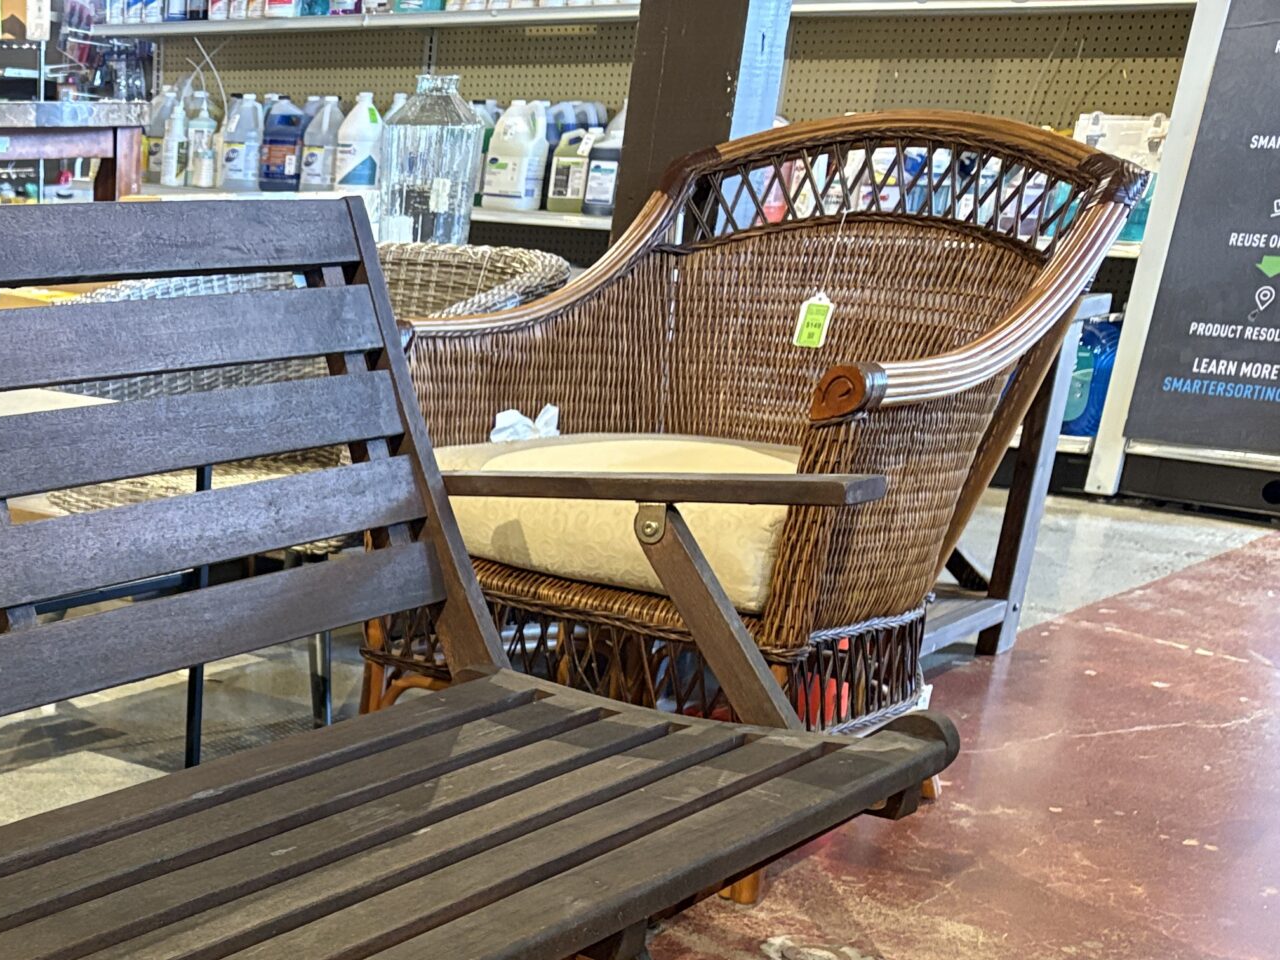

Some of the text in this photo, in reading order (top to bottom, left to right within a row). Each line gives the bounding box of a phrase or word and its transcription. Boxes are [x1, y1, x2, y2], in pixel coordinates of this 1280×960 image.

[1229, 232, 1267, 248] REUSE
[1189, 322, 1243, 339] PRODUCT
[1192, 357, 1280, 380] LEARN MORE
